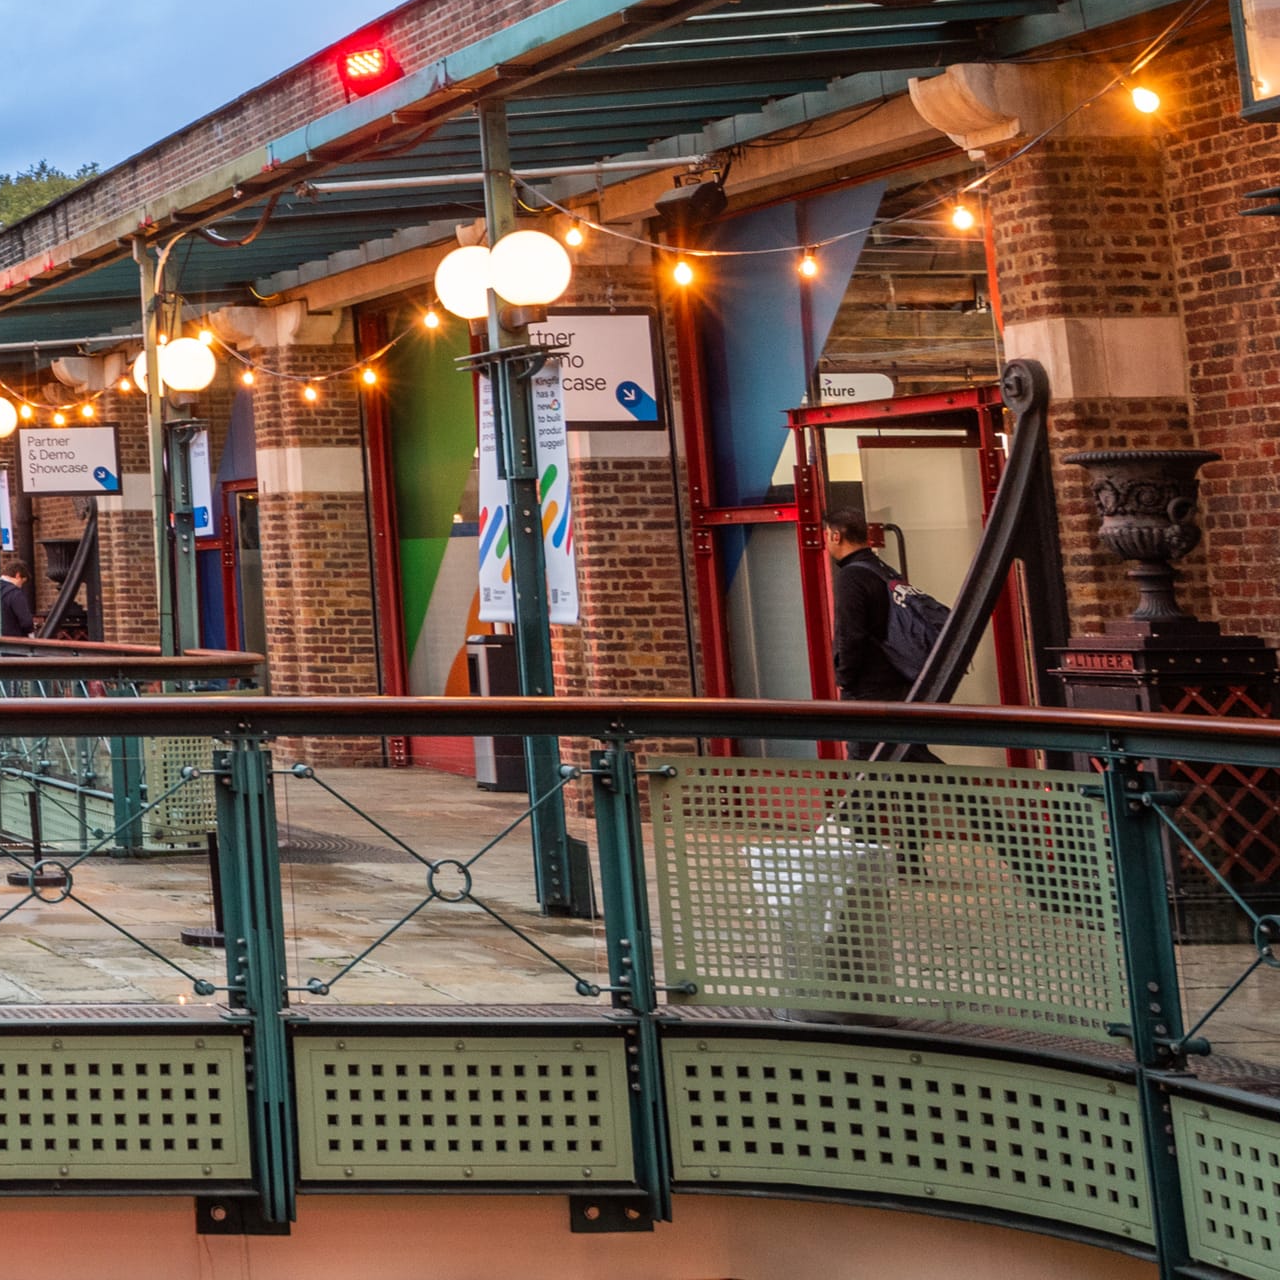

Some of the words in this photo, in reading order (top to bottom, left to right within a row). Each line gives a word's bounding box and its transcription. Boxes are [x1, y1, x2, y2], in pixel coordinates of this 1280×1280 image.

[529, 329, 576, 346] rtner
[559, 353, 584, 368] mo
[562, 377, 607, 391] case
[820, 386, 856, 397] nture
[27, 436, 70, 447] Partner
[28, 450, 37, 461] &
[39, 450, 76, 461] Demo
[29, 463, 88, 474] Showcase
[31, 477, 36, 488] 1
[1075, 654, 1123, 668] LITTER
